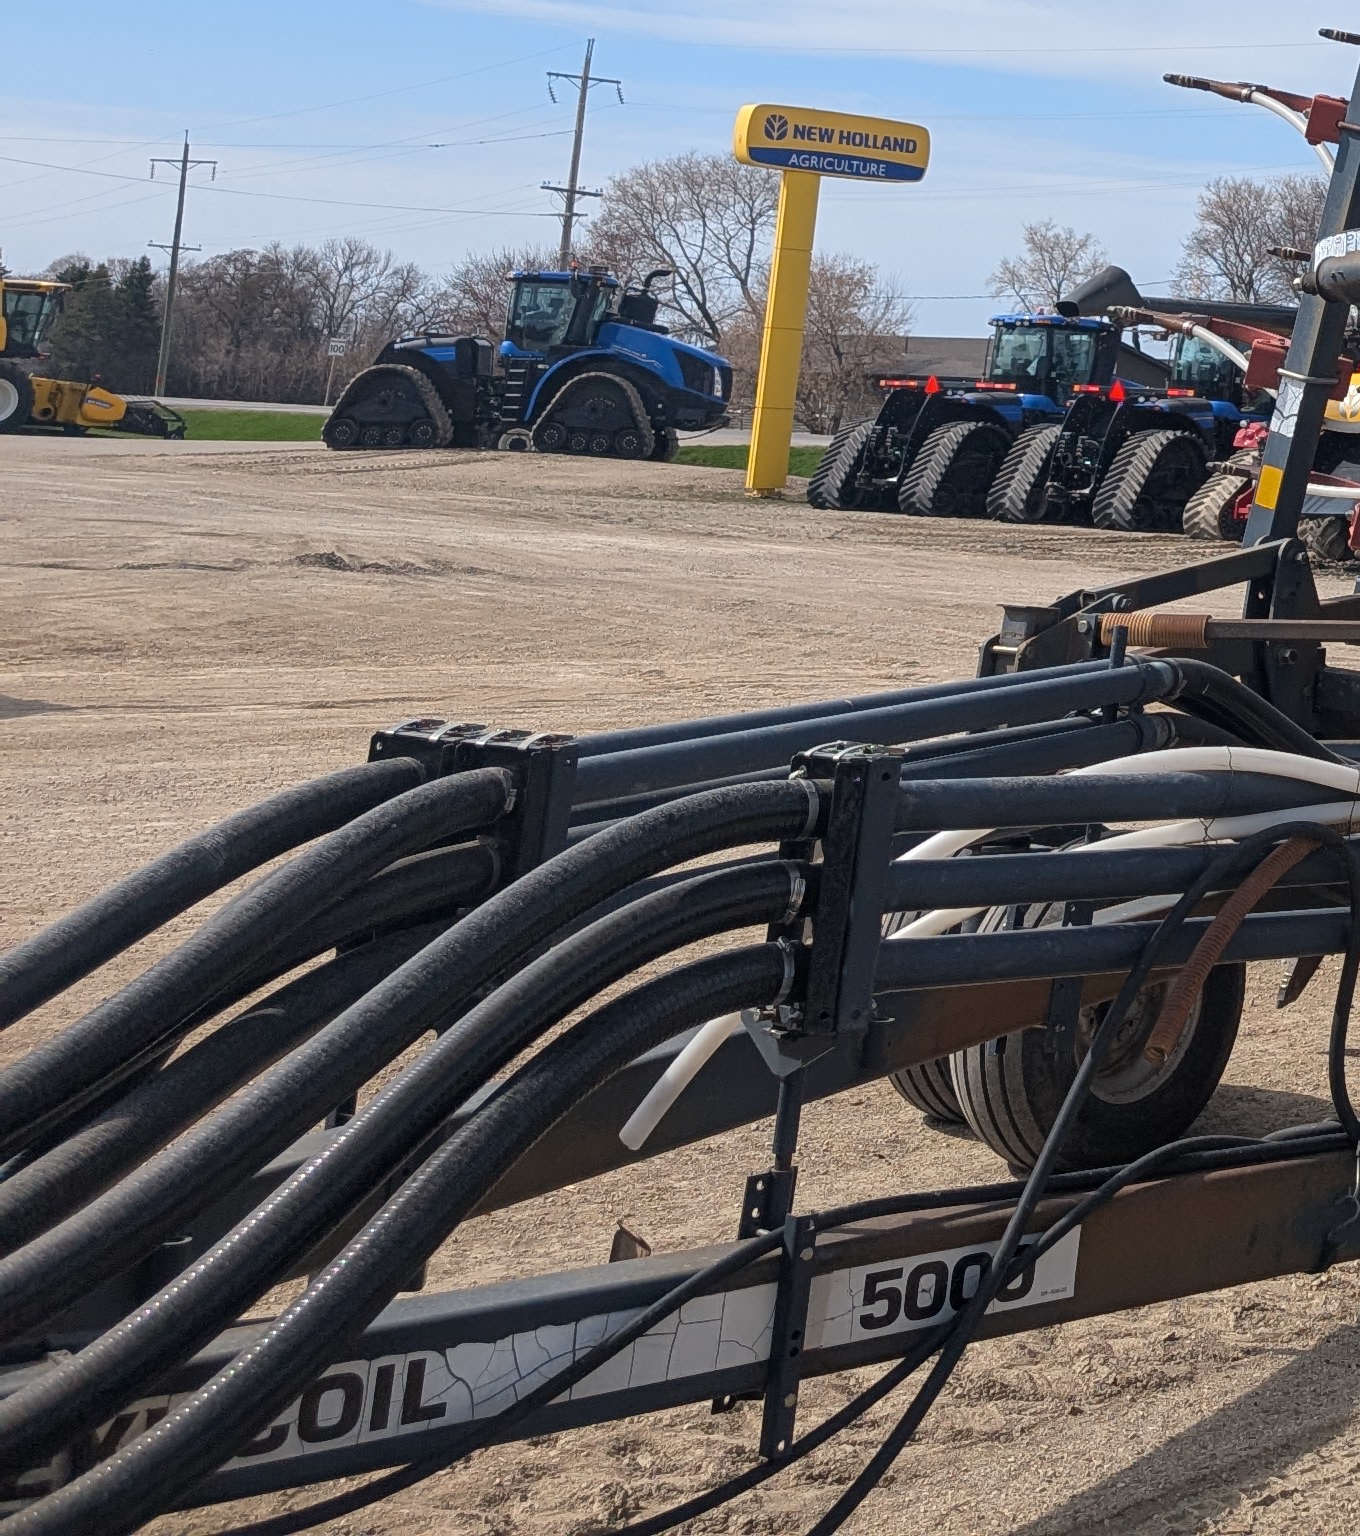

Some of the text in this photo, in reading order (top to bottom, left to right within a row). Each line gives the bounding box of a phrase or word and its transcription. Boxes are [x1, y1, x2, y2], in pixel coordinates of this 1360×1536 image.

[793, 123, 918, 154] NEW HOLLAND
[788, 153, 887, 177] AGRICULTURE
[330, 344, 345, 354] 100
